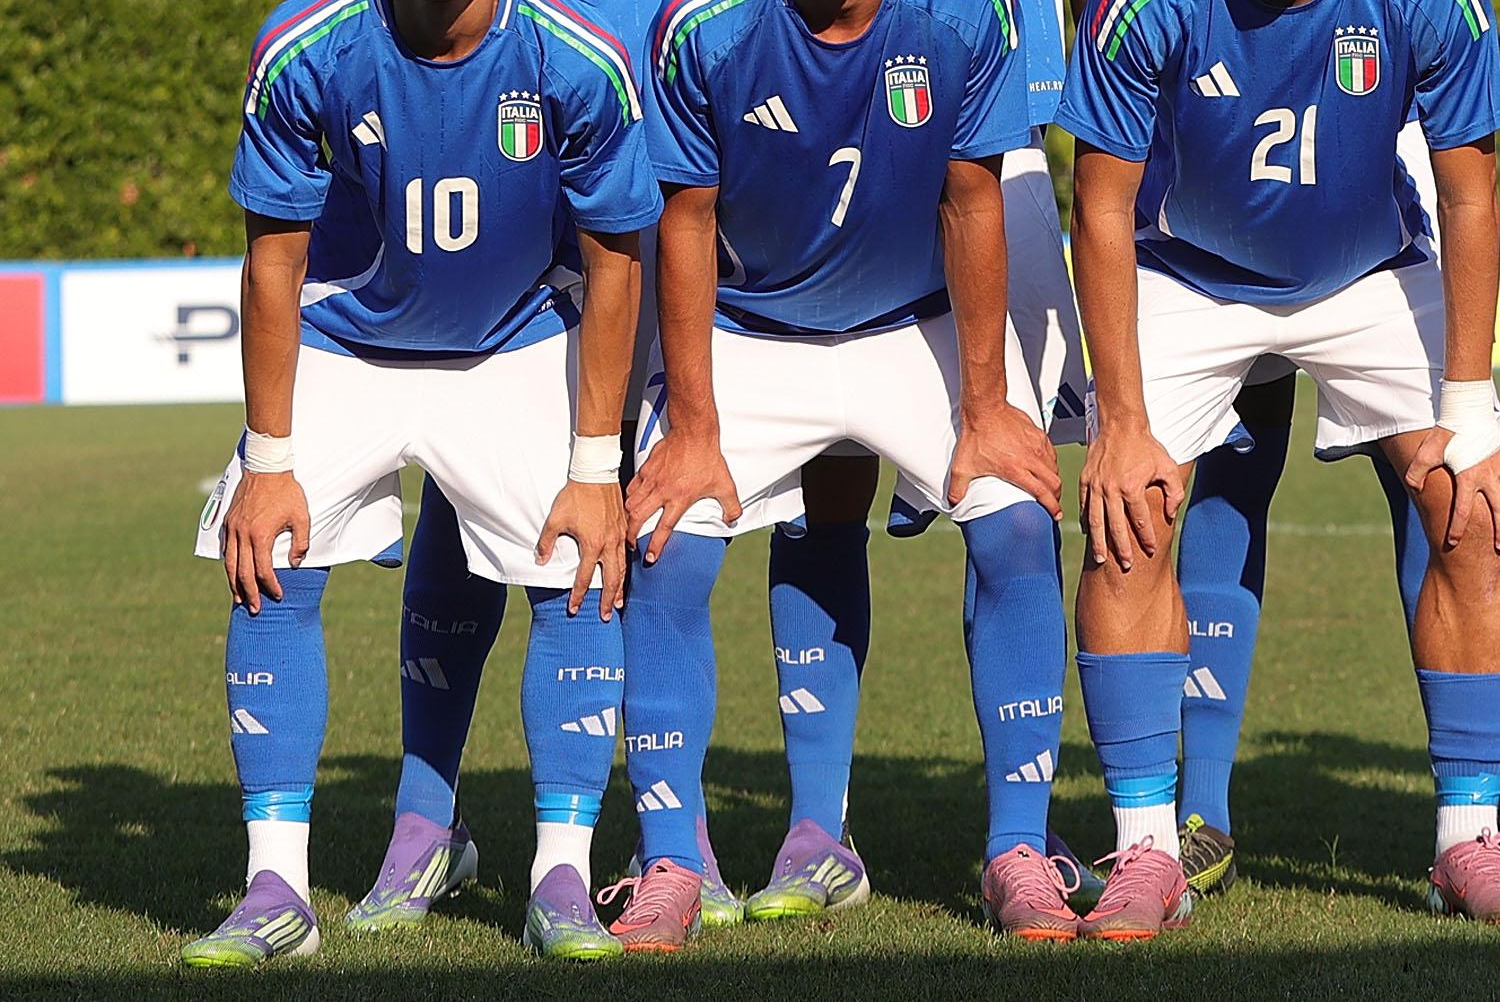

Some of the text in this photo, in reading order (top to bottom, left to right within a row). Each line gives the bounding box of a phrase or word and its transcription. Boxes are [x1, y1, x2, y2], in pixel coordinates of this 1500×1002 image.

[1339, 41, 1375, 54] ITALIA
[889, 70, 925, 85] ITALIA
[502, 106, 538, 119] ITALIA
[1250, 105, 1318, 185] 21
[828, 147, 861, 228] 7
[405, 177, 479, 254] 10
[403, 604, 479, 635] TALIA
[775, 646, 825, 665] ALIA
[227, 672, 273, 685] ALIA
[558, 666, 625, 681] ITALIA
[998, 695, 1063, 722] ITALIA
[625, 731, 684, 753] TALIA
